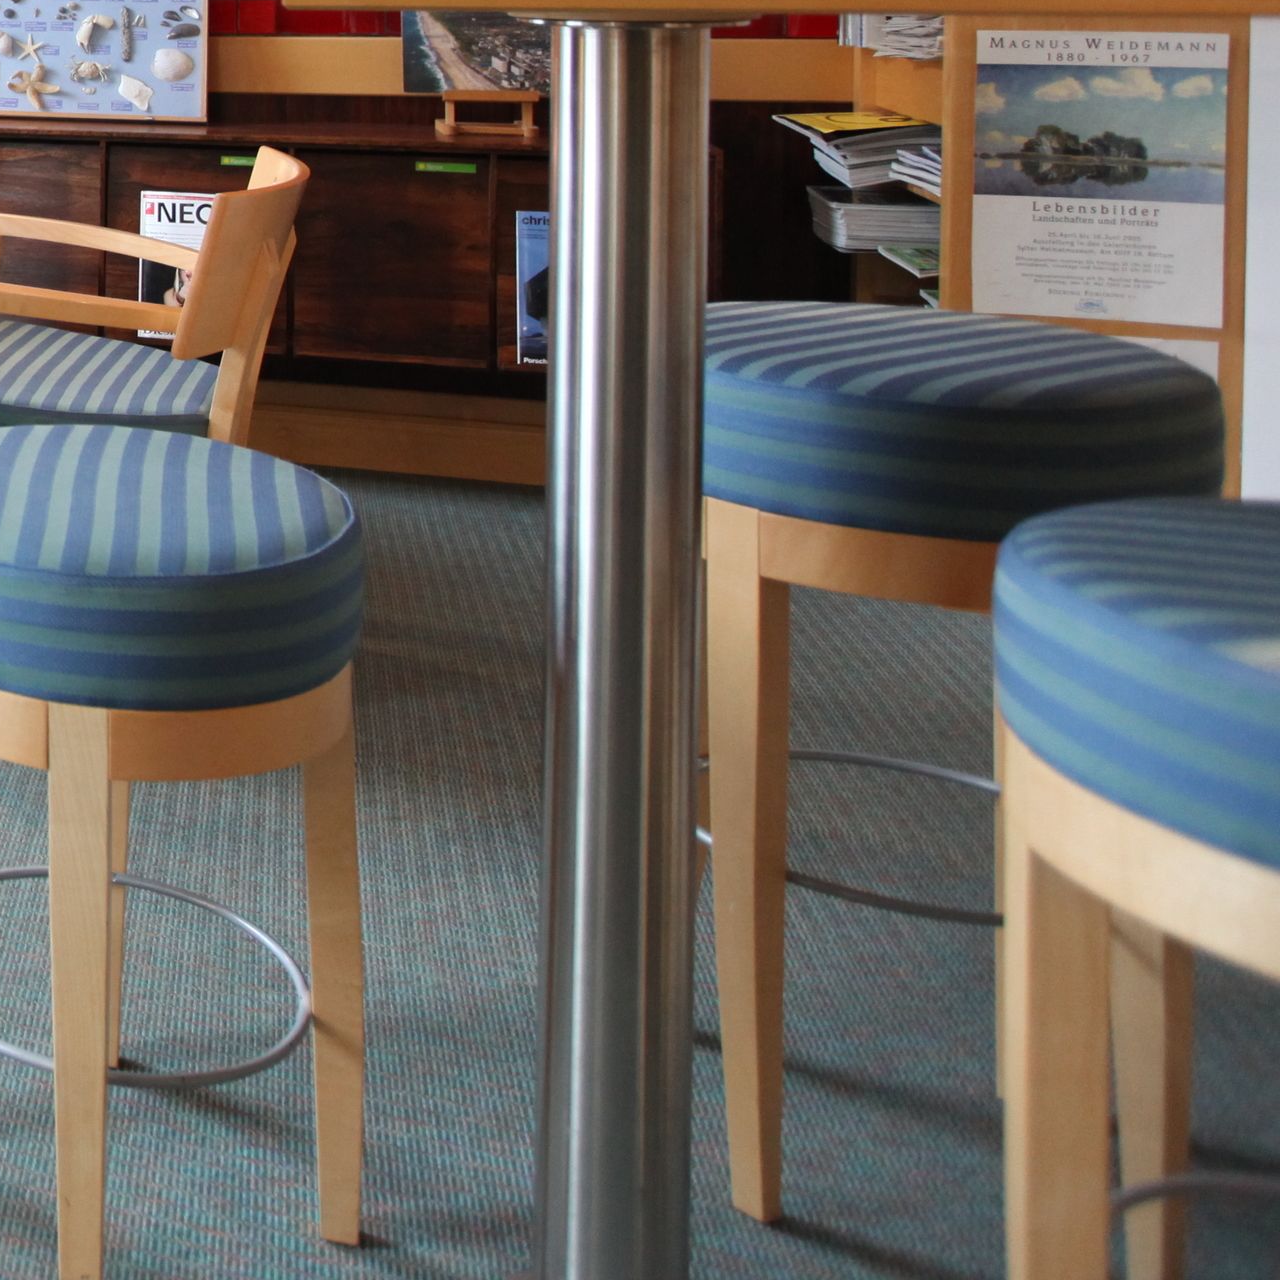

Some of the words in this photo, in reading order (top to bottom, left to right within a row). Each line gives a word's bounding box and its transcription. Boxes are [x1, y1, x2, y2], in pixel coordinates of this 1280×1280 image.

[990, 37, 1071, 49] MAGNUS
[1086, 38, 1217, 52] WEIDEMANN
[1047, 52, 1086, 62] 1880
[1111, 54, 1151, 63] 1967
[1032, 201, 1160, 217] Lebensbilder
[1032, 215, 1094, 225] Landschaften
[1098, 217, 1116, 225] und
[1120, 219, 1159, 228] Porträts
